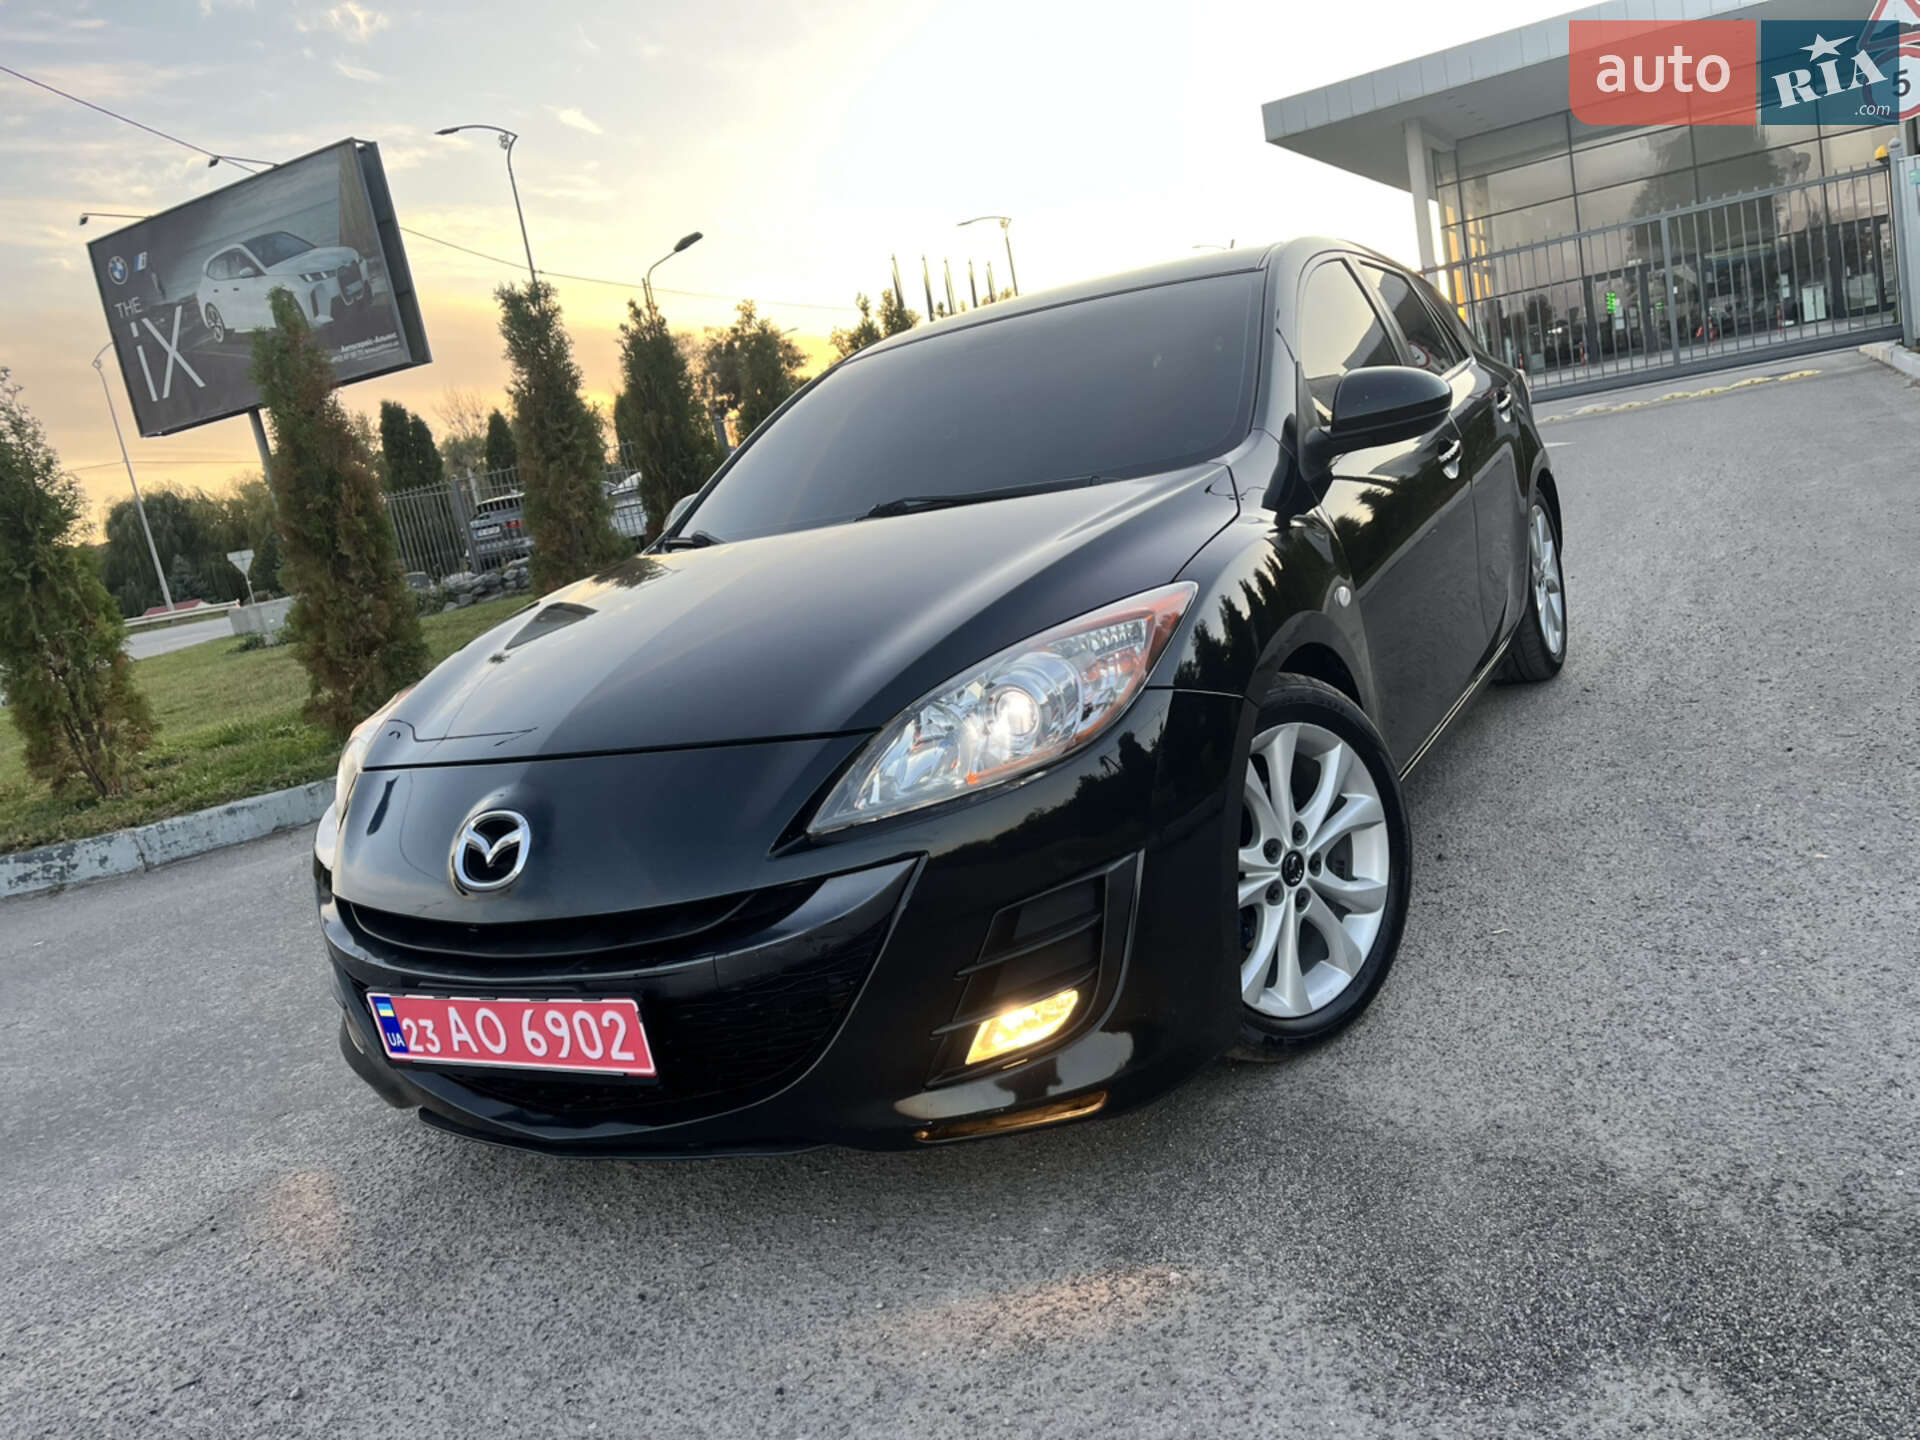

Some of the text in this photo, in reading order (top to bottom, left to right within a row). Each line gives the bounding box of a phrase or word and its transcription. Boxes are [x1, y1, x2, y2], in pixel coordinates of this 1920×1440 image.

[1892, 69, 1911, 97] 5
[114, 296, 143, 319] THE
[387, 1032, 405, 1048] UA
[402, 1006, 636, 1061] 23 AO 6902
